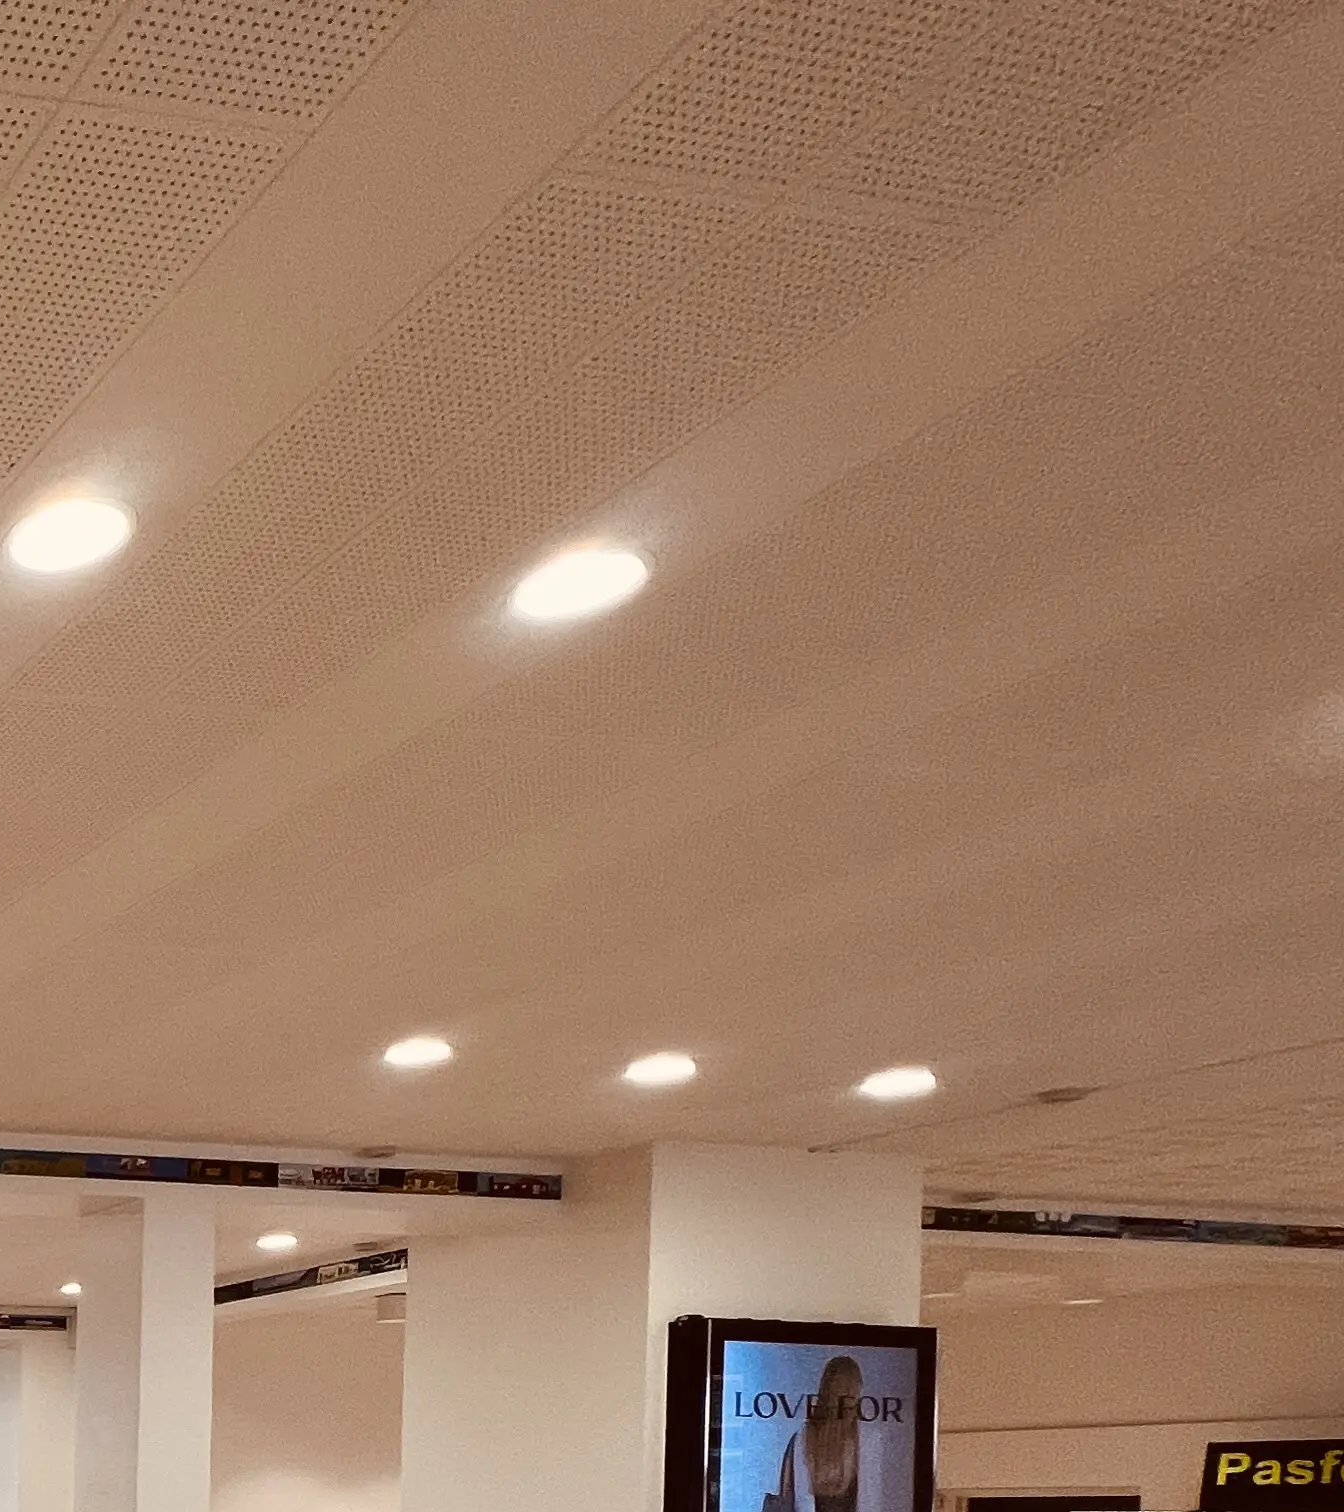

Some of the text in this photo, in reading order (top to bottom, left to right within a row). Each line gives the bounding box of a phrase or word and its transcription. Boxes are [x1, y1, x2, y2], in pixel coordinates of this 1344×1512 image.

[734, 1391, 904, 1423] LOVE FOR
[1215, 1449, 1344, 1486] Pasf
